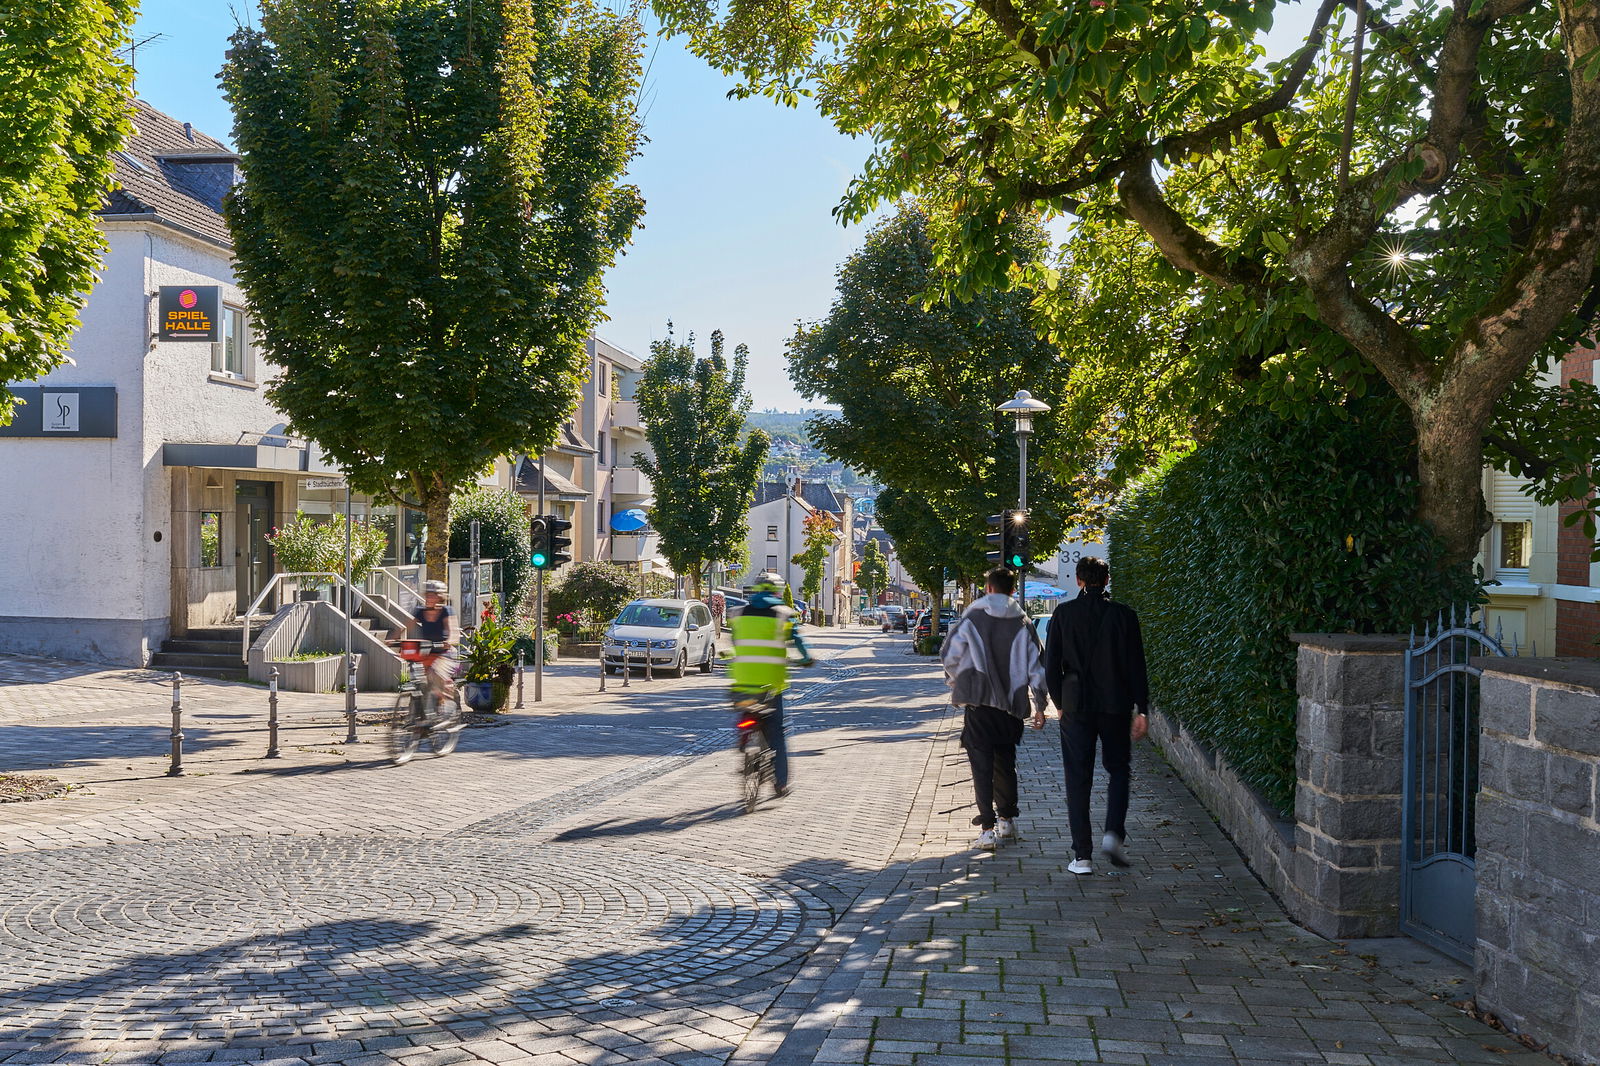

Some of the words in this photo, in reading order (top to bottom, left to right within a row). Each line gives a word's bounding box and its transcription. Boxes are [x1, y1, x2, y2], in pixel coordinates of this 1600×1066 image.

[168, 311, 208, 320] SPIEL
[165, 321, 211, 331] HALLE
[1061, 550, 1081, 564] 33
